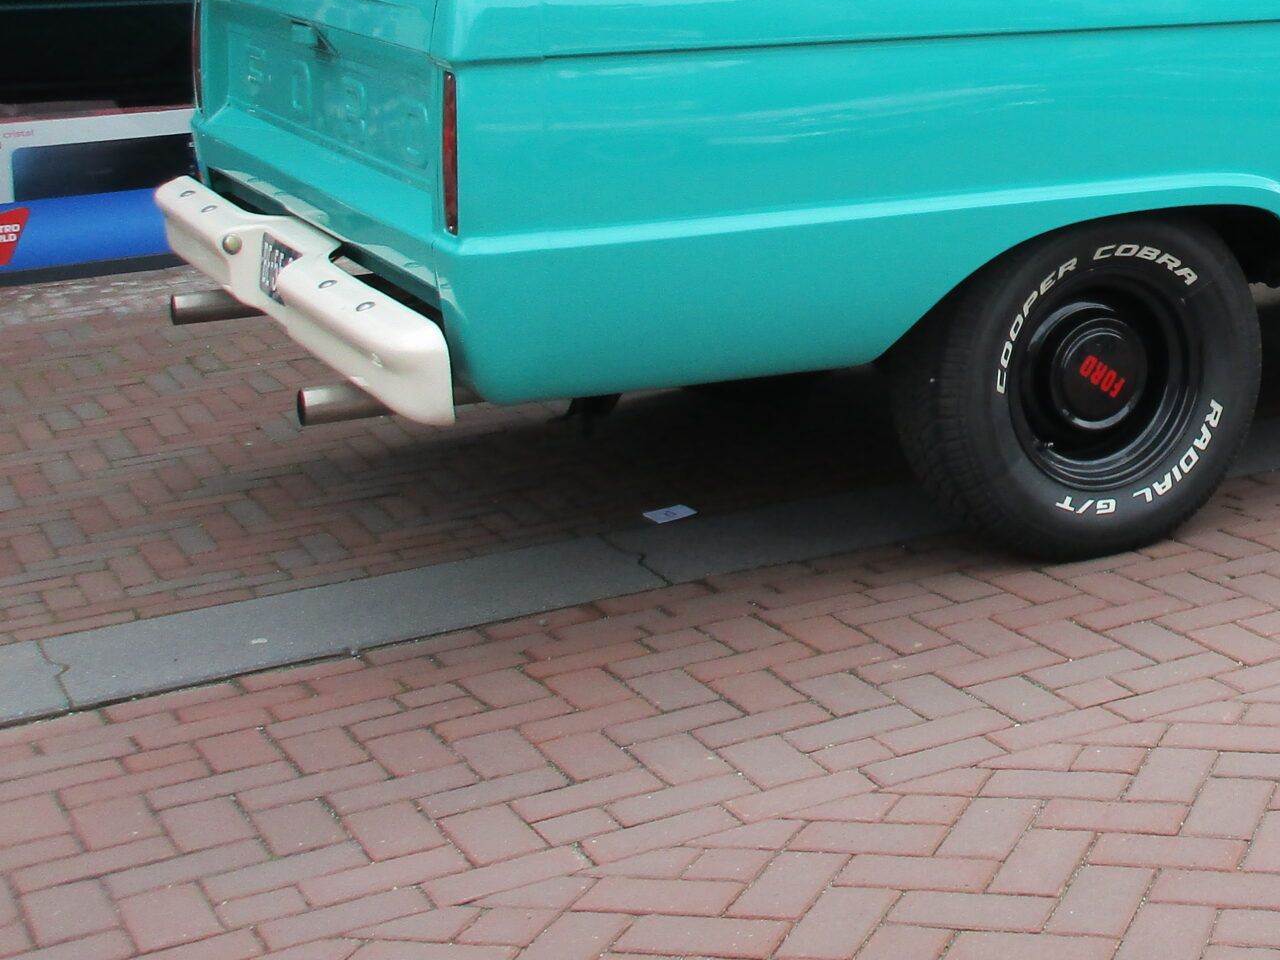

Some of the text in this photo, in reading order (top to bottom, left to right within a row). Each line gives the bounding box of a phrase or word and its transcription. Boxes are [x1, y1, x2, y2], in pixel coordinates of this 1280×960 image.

[996, 243, 1198, 394] COOPER COBRA
[1079, 355, 1126, 398] FORD
[1055, 399, 1224, 515] RADIAL G/T
